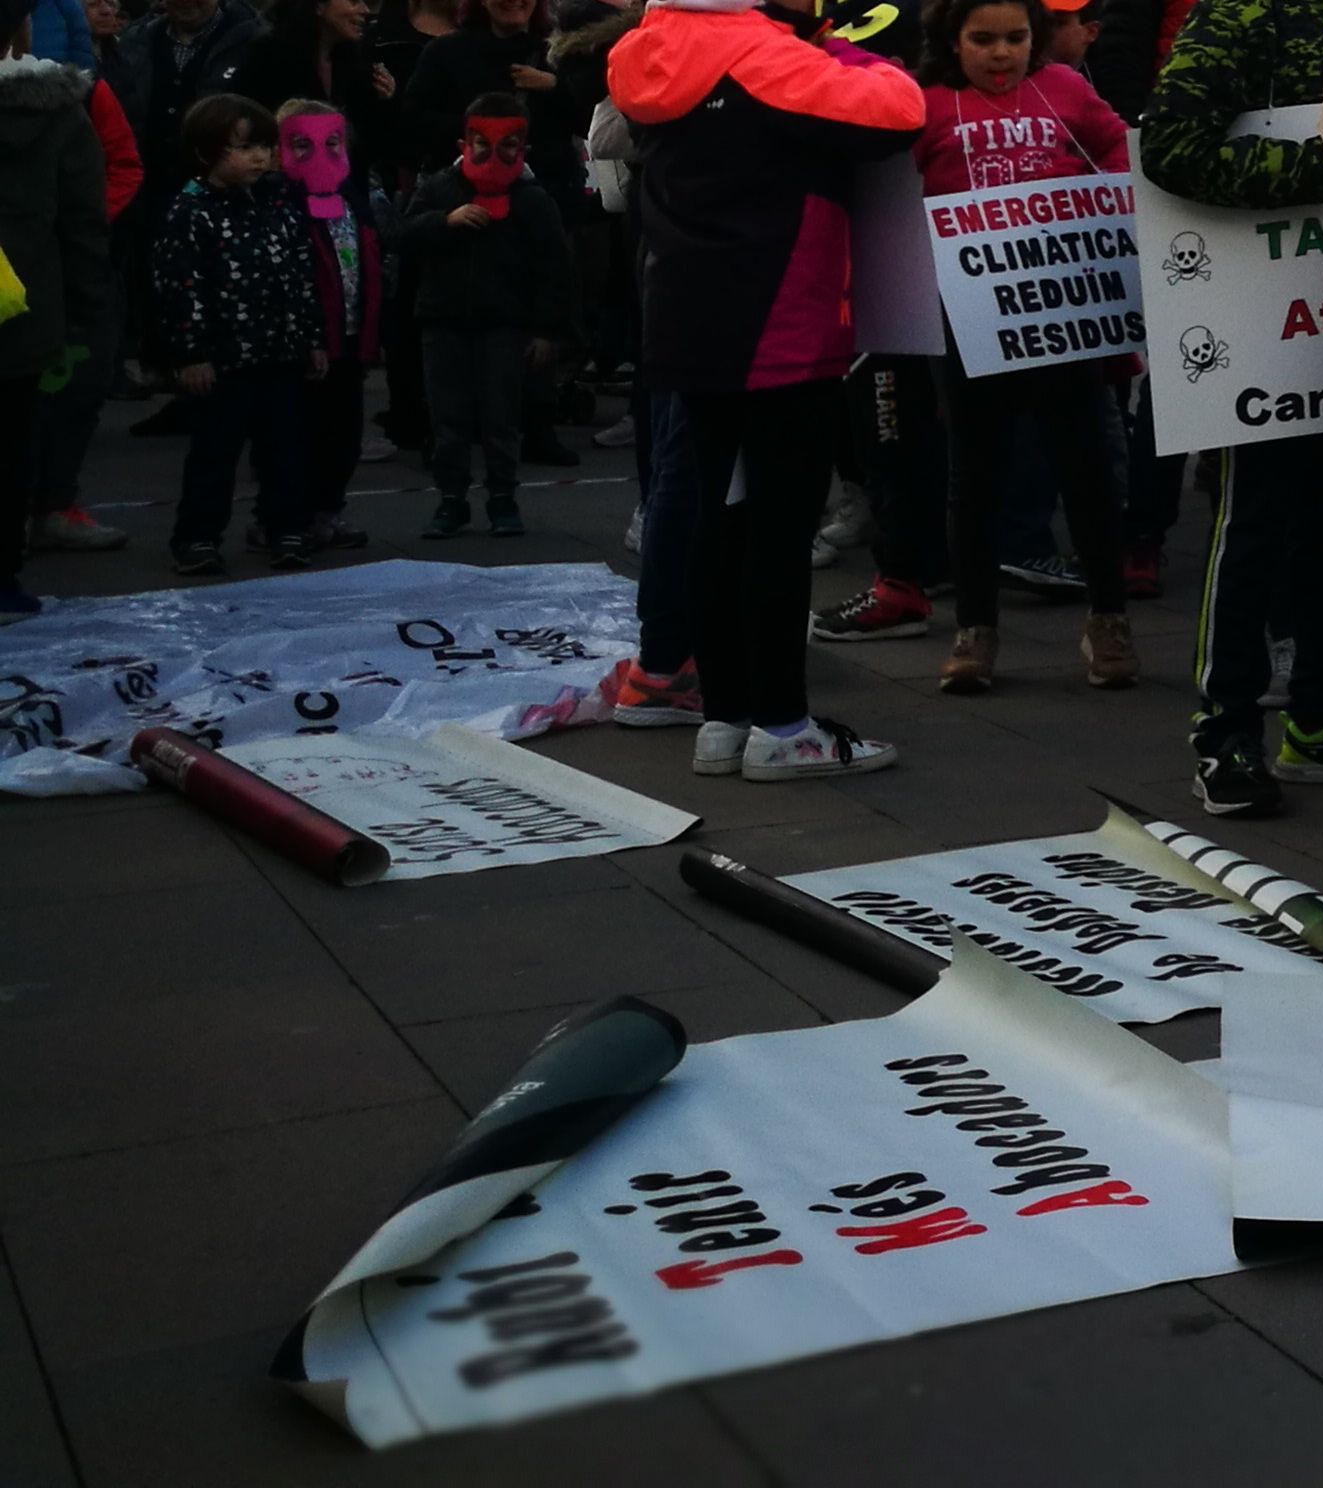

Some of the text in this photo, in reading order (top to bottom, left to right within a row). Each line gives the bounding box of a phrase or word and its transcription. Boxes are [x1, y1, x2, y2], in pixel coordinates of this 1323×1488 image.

[954, 117, 1057, 153] TIME
[960, 228, 1138, 276] CLIMÀTICA
[994, 268, 1126, 315] REDUÏM
[997, 312, 1146, 360] RESIDUS
[887, 1053, 1150, 1216] Abocadors
[605, 1170, 803, 1289] Tenir
